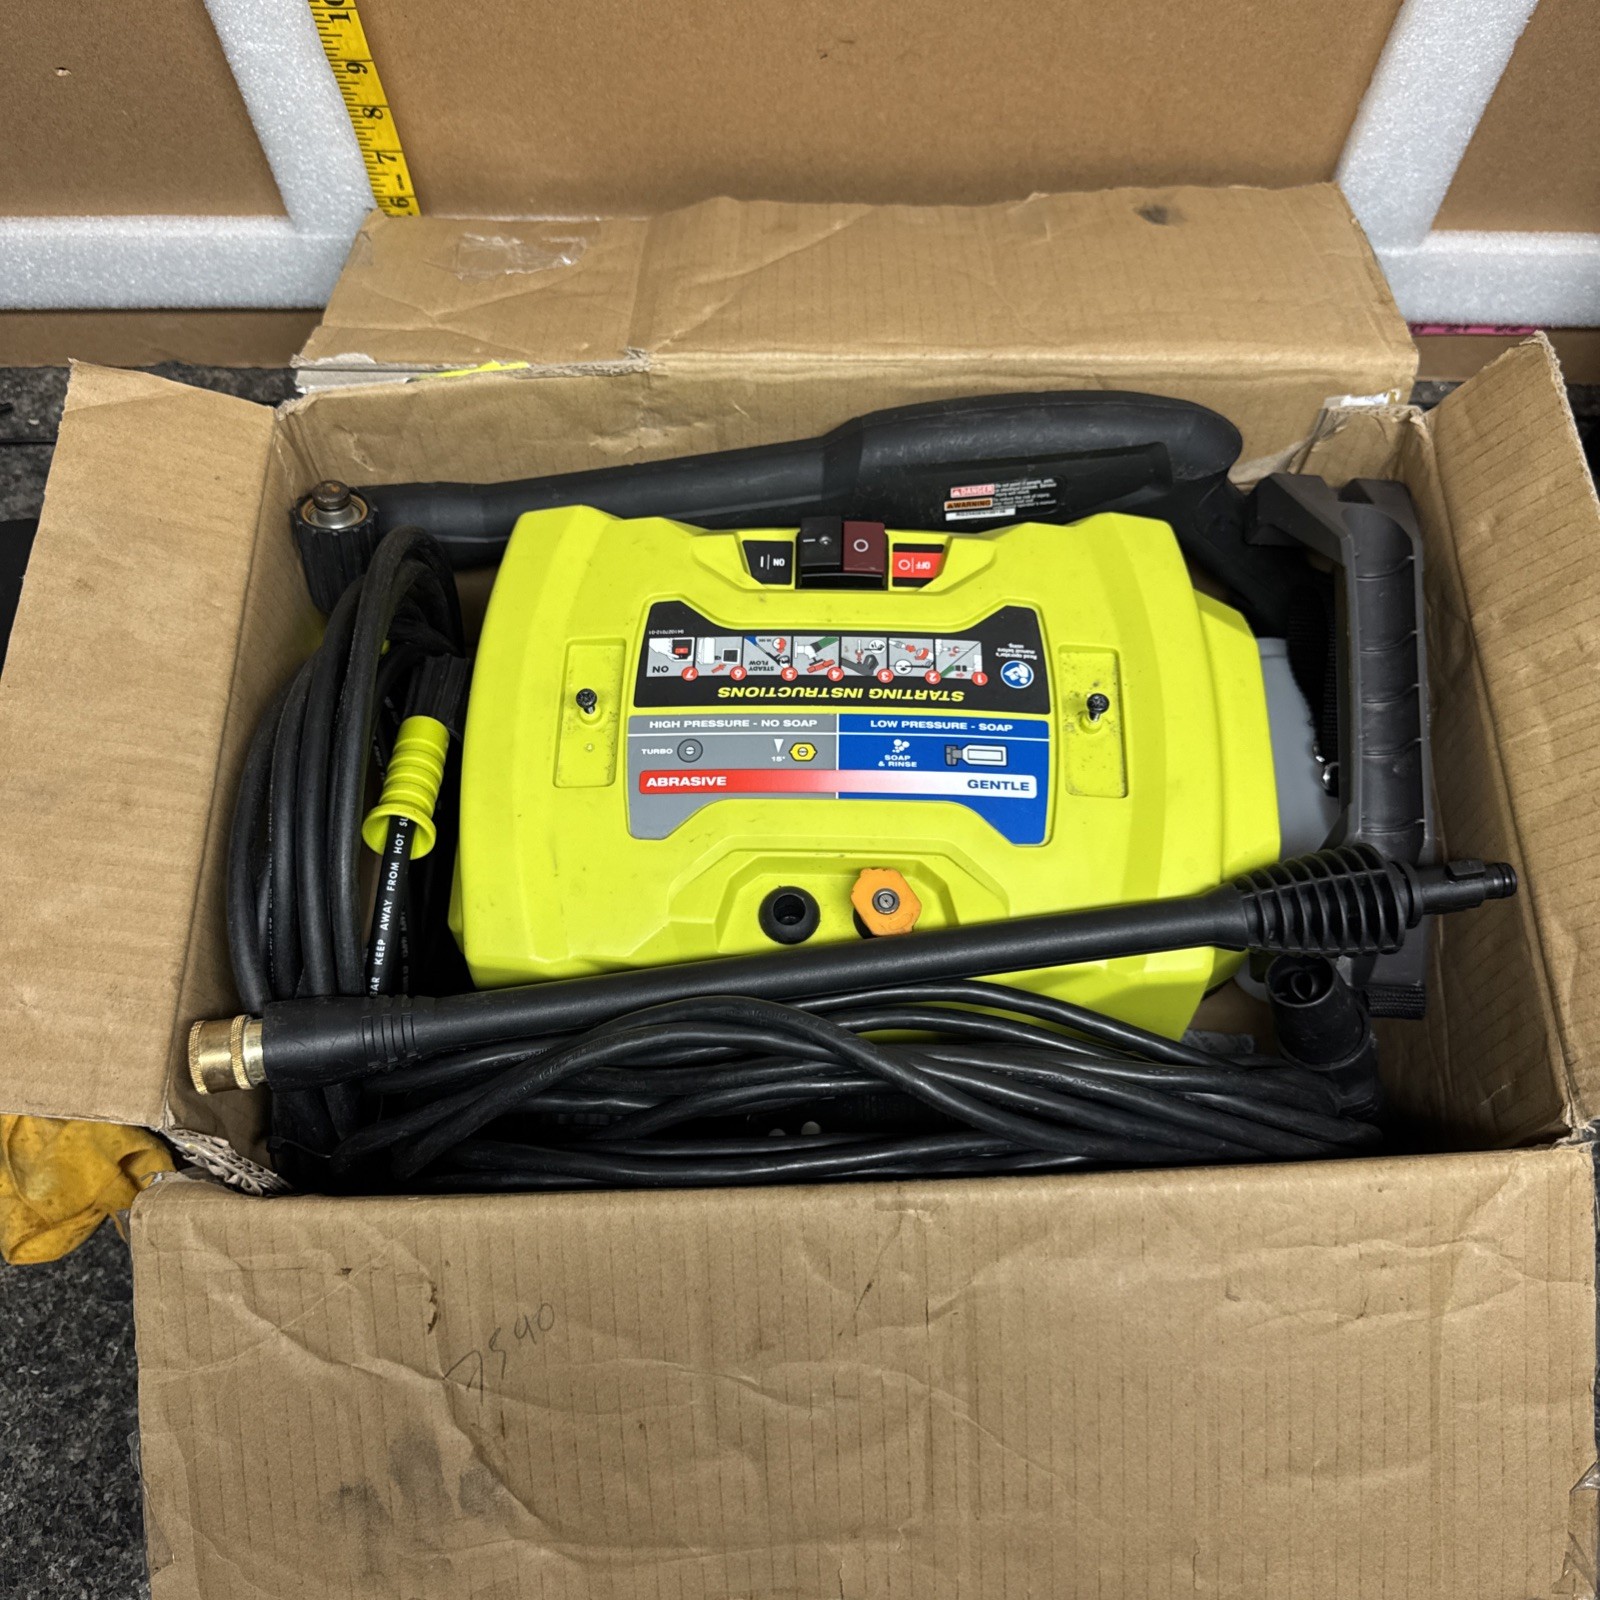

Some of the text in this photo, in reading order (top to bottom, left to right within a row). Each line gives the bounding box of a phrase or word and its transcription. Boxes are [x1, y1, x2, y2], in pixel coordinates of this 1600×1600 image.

[346, 61, 369, 75] 9
[363, 106, 384, 120] 8
[377, 151, 397, 164] 7
[390, 197, 410, 209] 6
[961, 484, 993, 496] DANGER
[954, 500, 991, 509] WARNING
[773, 558, 785, 567] ON
[916, 561, 931, 570] OFF
[652, 665, 669, 673] ON
[686, 669, 694, 678] 7
[734, 669, 741, 678] 6
[785, 669, 793, 678] 5
[832, 669, 840, 679] 4
[881, 671, 889, 680] 3
[930, 672, 937, 681] 2
[977, 674, 983, 683] 1
[717, 686, 965, 702] STARTING INSTRUCTIONS
[649, 720, 680, 729] HIGH
[684, 719, 750, 728] PRESSURE
[761, 719, 780, 728] NO
[783, 719, 818, 728] SOAP
[870, 720, 898, 728] LOW
[901, 720, 968, 730] PRESSURE
[978, 723, 1013, 732] SOAP
[646, 776, 727, 787] ABRASIVE
[967, 779, 1030, 791] GENTLE
[393, 833, 405, 854] HOT
[387, 862, 400, 891] FROM
[380, 899, 393, 931] AWAY
[374, 939, 386, 965] KEEP
